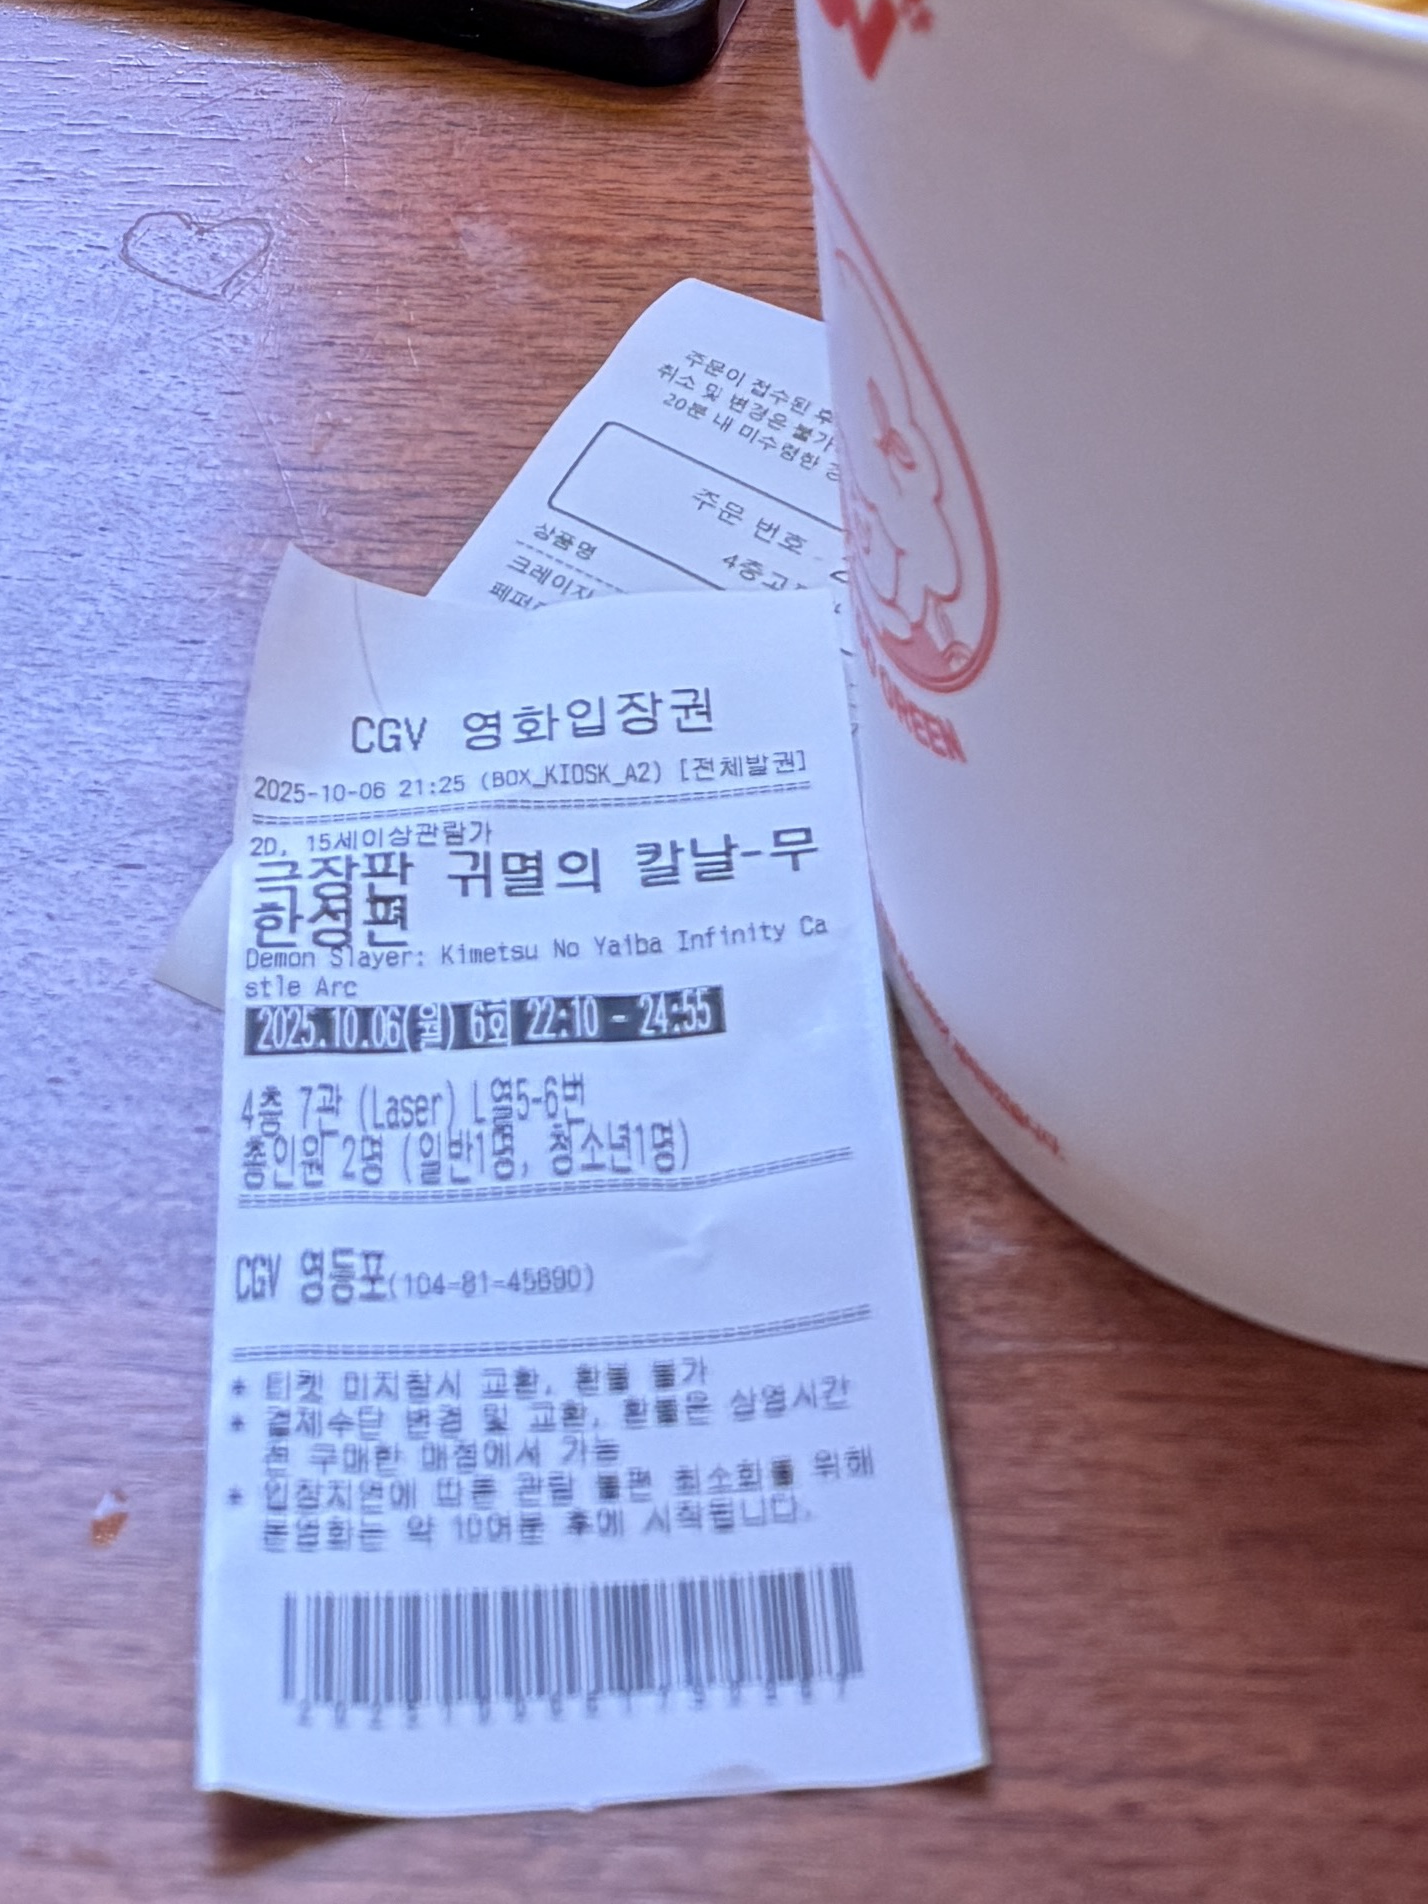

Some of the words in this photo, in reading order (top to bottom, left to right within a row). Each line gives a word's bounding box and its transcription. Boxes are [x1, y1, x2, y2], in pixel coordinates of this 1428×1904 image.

[657, 363, 696, 390] 취소
[685, 349, 746, 387] 주문이
[662, 392, 709, 421] 20분
[713, 412, 734, 433] 내
[533, 522, 598, 561] 상품명
[692, 487, 745, 528] 주문
[753, 517, 809, 556] 번호
[488, 581, 548, 611] 페퍼
[351, 715, 428, 754] CGV
[463, 687, 713, 751] 영화입장권
[253, 776, 386, 804] 2025-10-06
[399, 774, 466, 798] 21:25
[481, 761, 662, 791] (BOX_KIOSK_A2)
[680, 749, 807, 783] [전체발권]
[249, 836, 287, 858] 2D,
[307, 820, 492, 853] 15세이상관람가
[253, 850, 414, 901] 극장판
[447, 848, 601, 898] 귀멸의
[636, 826, 819, 888] 칼날-무
[245, 948, 315, 970] Demon
[330, 947, 424, 970] Slayer:
[441, 943, 538, 965] Kimetsu
[554, 938, 580, 958] No
[594, 933, 663, 957] Yaiba
[678, 921, 786, 953] Infinity
[799, 915, 828, 937] Ca
[253, 896, 409, 949] 한성편
[244, 976, 301, 998] stle
[316, 976, 358, 997] Arc
[256, 1002, 455, 1051] 2025.10.06(월)
[470, 998, 511, 1047] 6회
[525, 995, 600, 1041] 22:10
[638, 987, 712, 1036] 24:55
[241, 1085, 283, 1138] 4층
[299, 1083, 342, 1138] 7관
[359, 1079, 456, 1134] (Laser)
[243, 1134, 324, 1189] 총인원
[341, 1133, 383, 1186] 2명
[550, 1118, 689, 1176] 청소년1명)
[235, 1252, 281, 1303] CGV
[266, 1369, 323, 1404] 티켓
[814, 1443, 874, 1480] 위해
